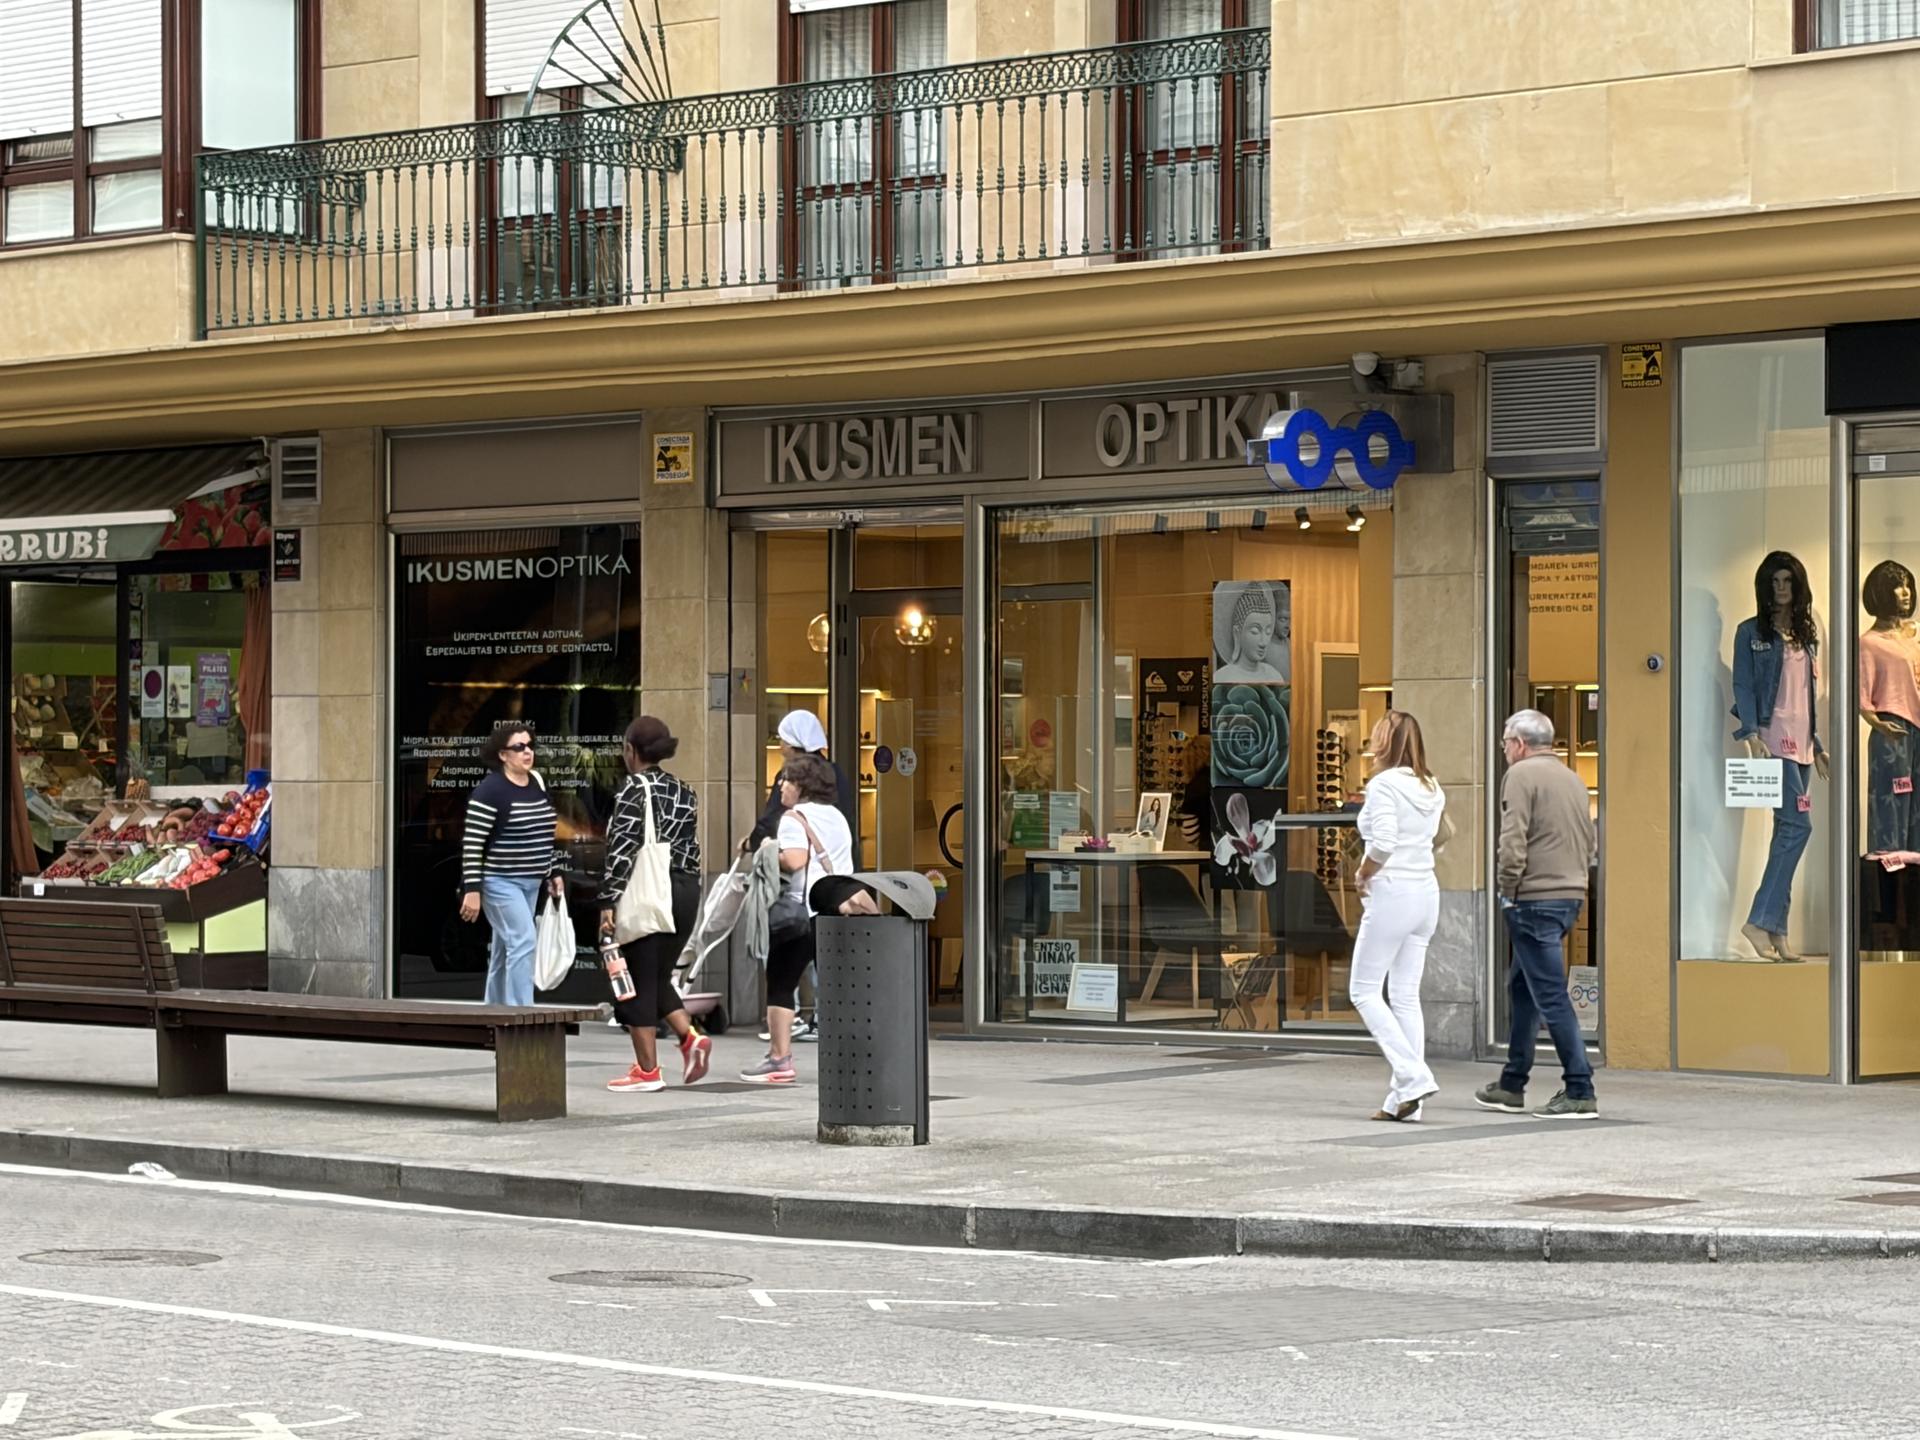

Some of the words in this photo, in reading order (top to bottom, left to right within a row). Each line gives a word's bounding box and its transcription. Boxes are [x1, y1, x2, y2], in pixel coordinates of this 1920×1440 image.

[764, 413, 974, 484] IKUSMEN
[495, 646, 507, 655] EN
[546, 644, 558, 654] DE
[1033, 942, 1072, 952] ENTSIO
[1034, 983, 1069, 994] IGNA
